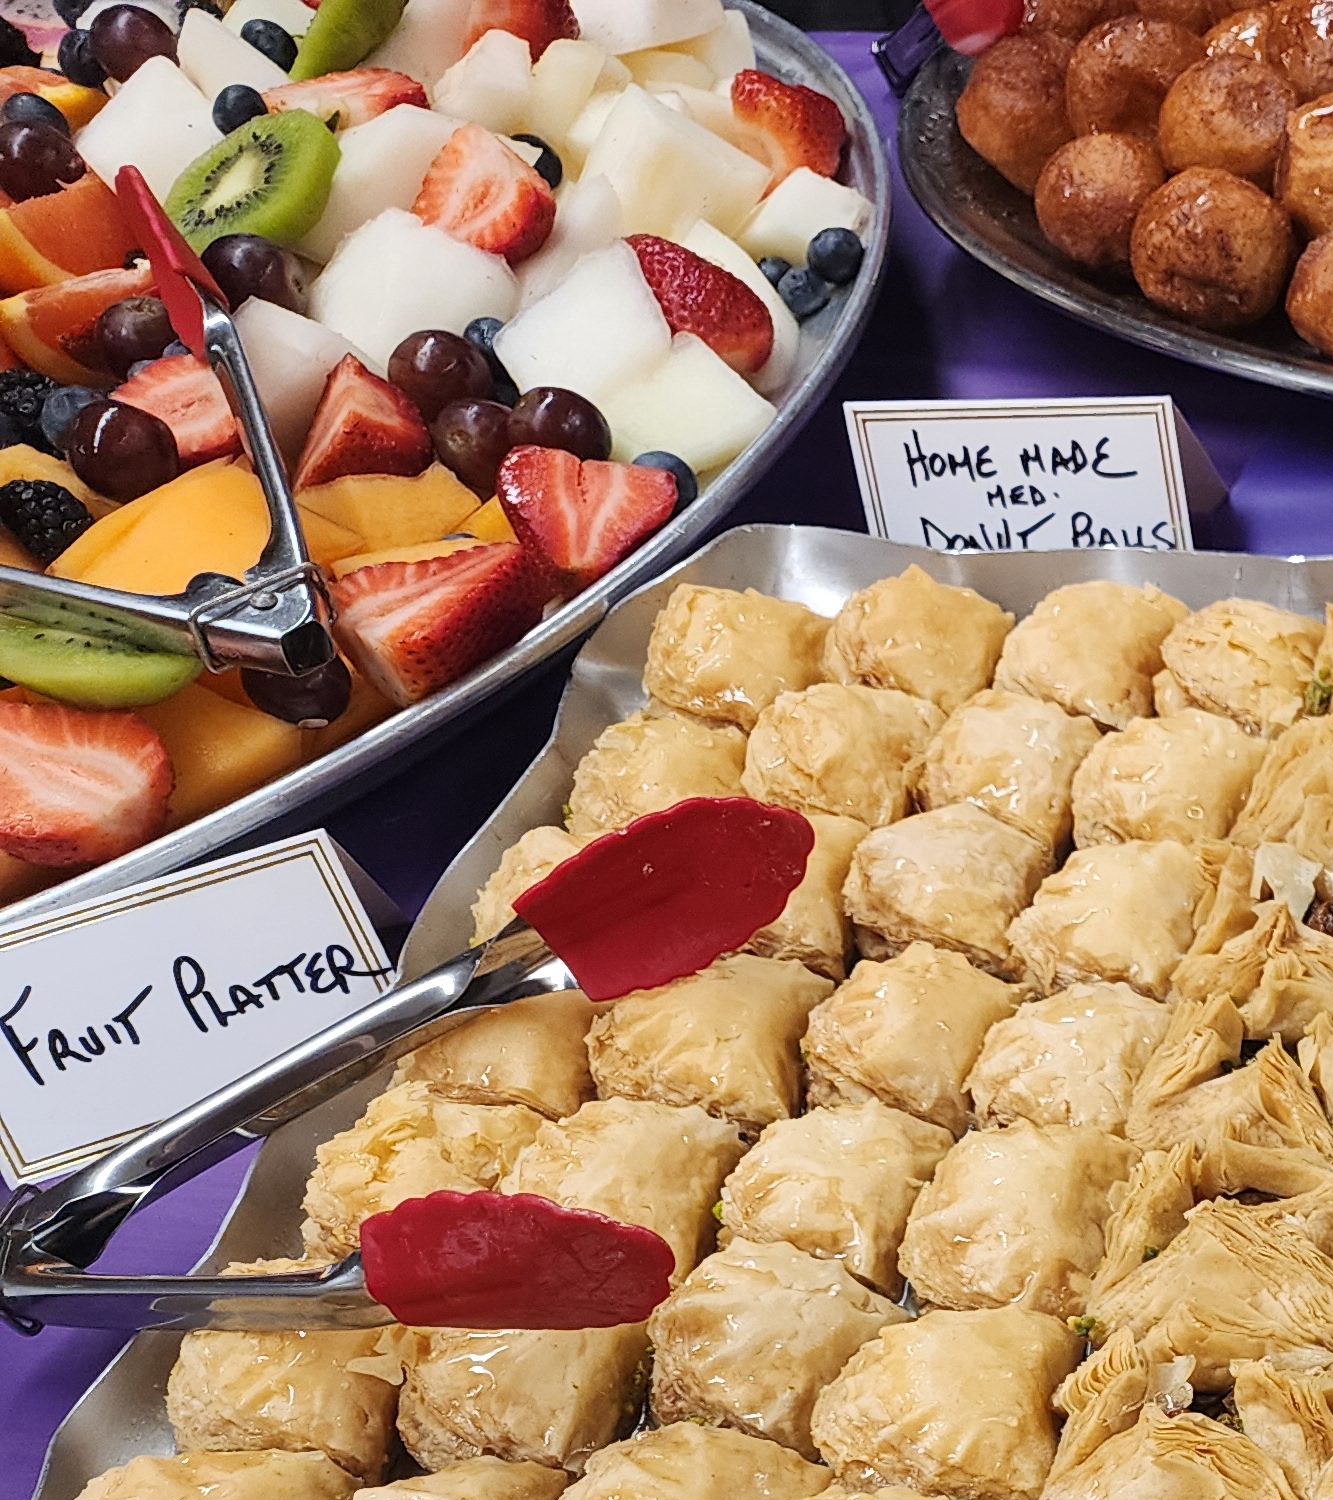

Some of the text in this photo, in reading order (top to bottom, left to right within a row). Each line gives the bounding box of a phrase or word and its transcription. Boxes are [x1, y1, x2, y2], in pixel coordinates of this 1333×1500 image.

[903, 429, 1139, 488] HOME MADE
[0, 943, 395, 1086] FRUIT PLATTER
